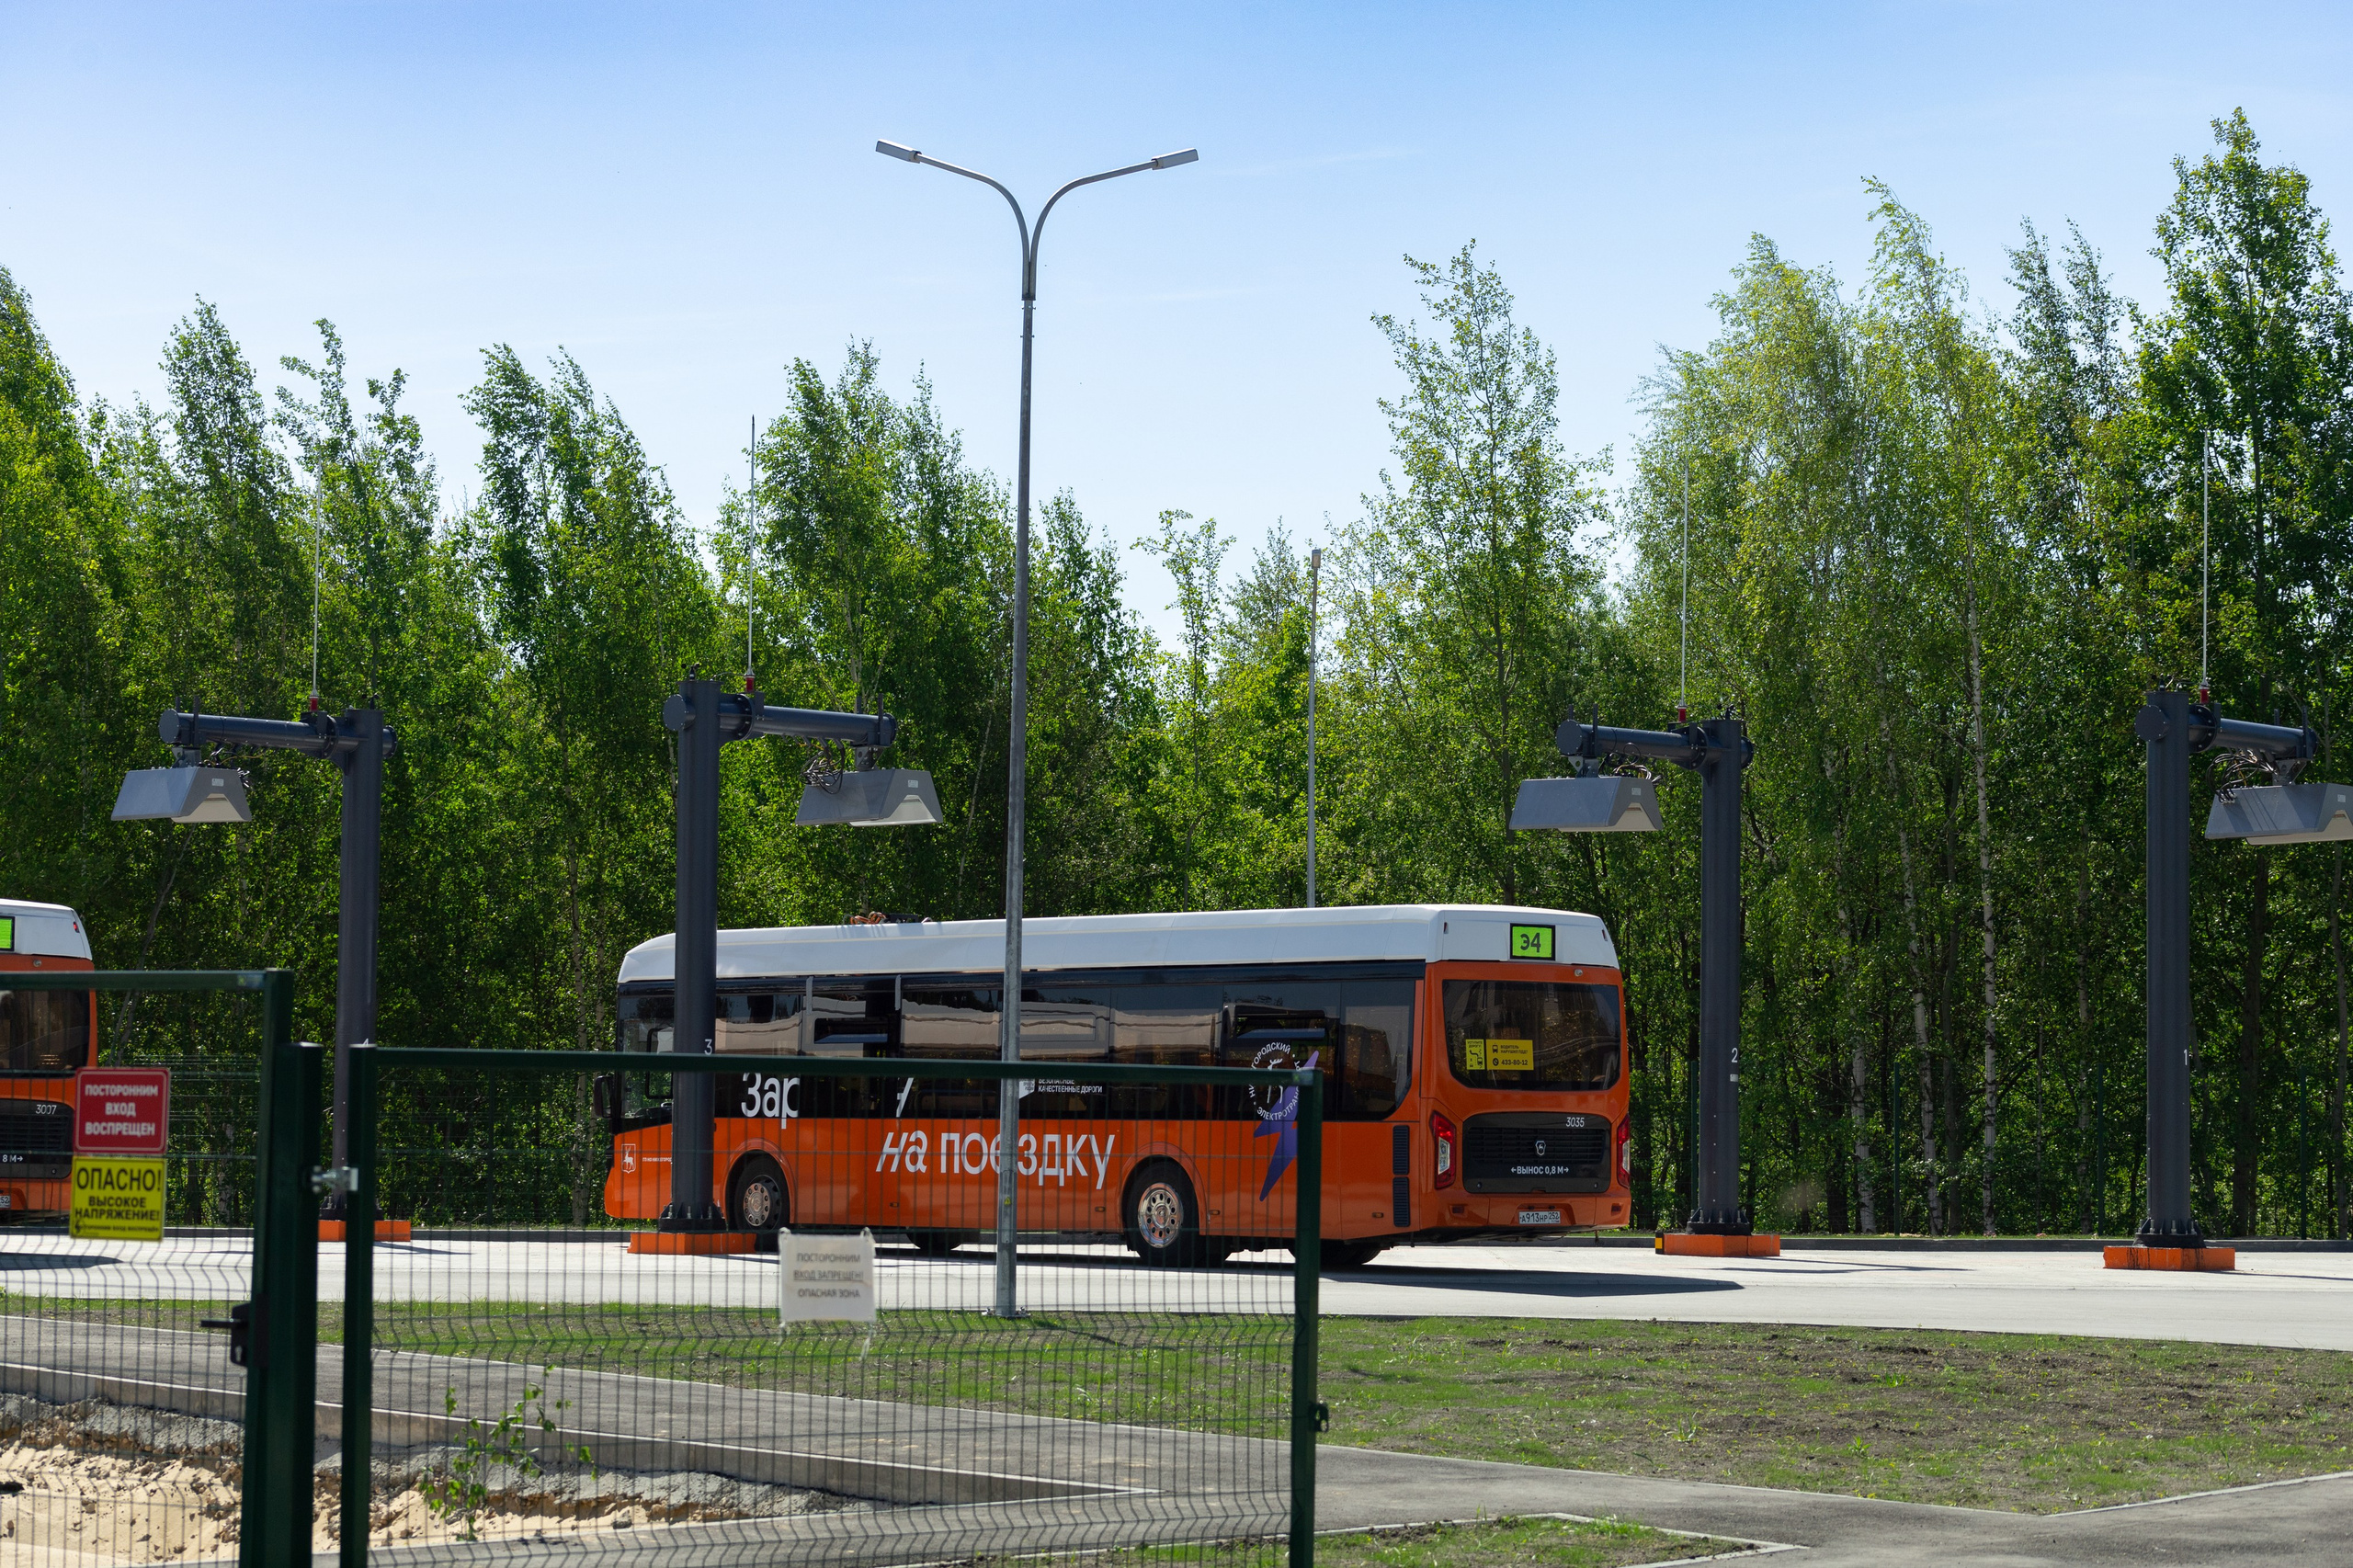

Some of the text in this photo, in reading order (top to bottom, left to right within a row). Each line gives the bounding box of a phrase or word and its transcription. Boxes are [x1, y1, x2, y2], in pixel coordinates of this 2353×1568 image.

[1520, 932, 1541, 953] Э4
[704, 1039, 712, 1055] 3
[1731, 1047, 1738, 1063] 2
[2183, 1049, 2188, 1066] 1
[85, 1085, 159, 1096] ПОСТОРОННИМ
[1080, 1085, 1103, 1095] ДОРОГИ
[36, 1104, 57, 1115] 3007
[105, 1102, 136, 1118] ВХОД
[1565, 1117, 1586, 1128] 3035
[85, 1121, 155, 1137] ВОСПРЕЩЕН
[875, 1130, 927, 1174] на
[1517, 1165, 1564, 1176] ВЫНОС 0,8 М
[76, 1167, 162, 1192] ОПАСНО!
[0, 1196, 9, 1204] 52
[88, 1196, 146, 1209] ВЫСОКОЕ
[74, 1208, 160, 1221] НАПРЯЖЕНИЕ!
[1521, 1211, 1559, 1222] А913НР 252
[797, 1253, 861, 1262] ПОСТОРОННИМ
[793, 1270, 816, 1279] ВХОД
[798, 1289, 861, 1298] ОПАСНАЯ ЗОНА
